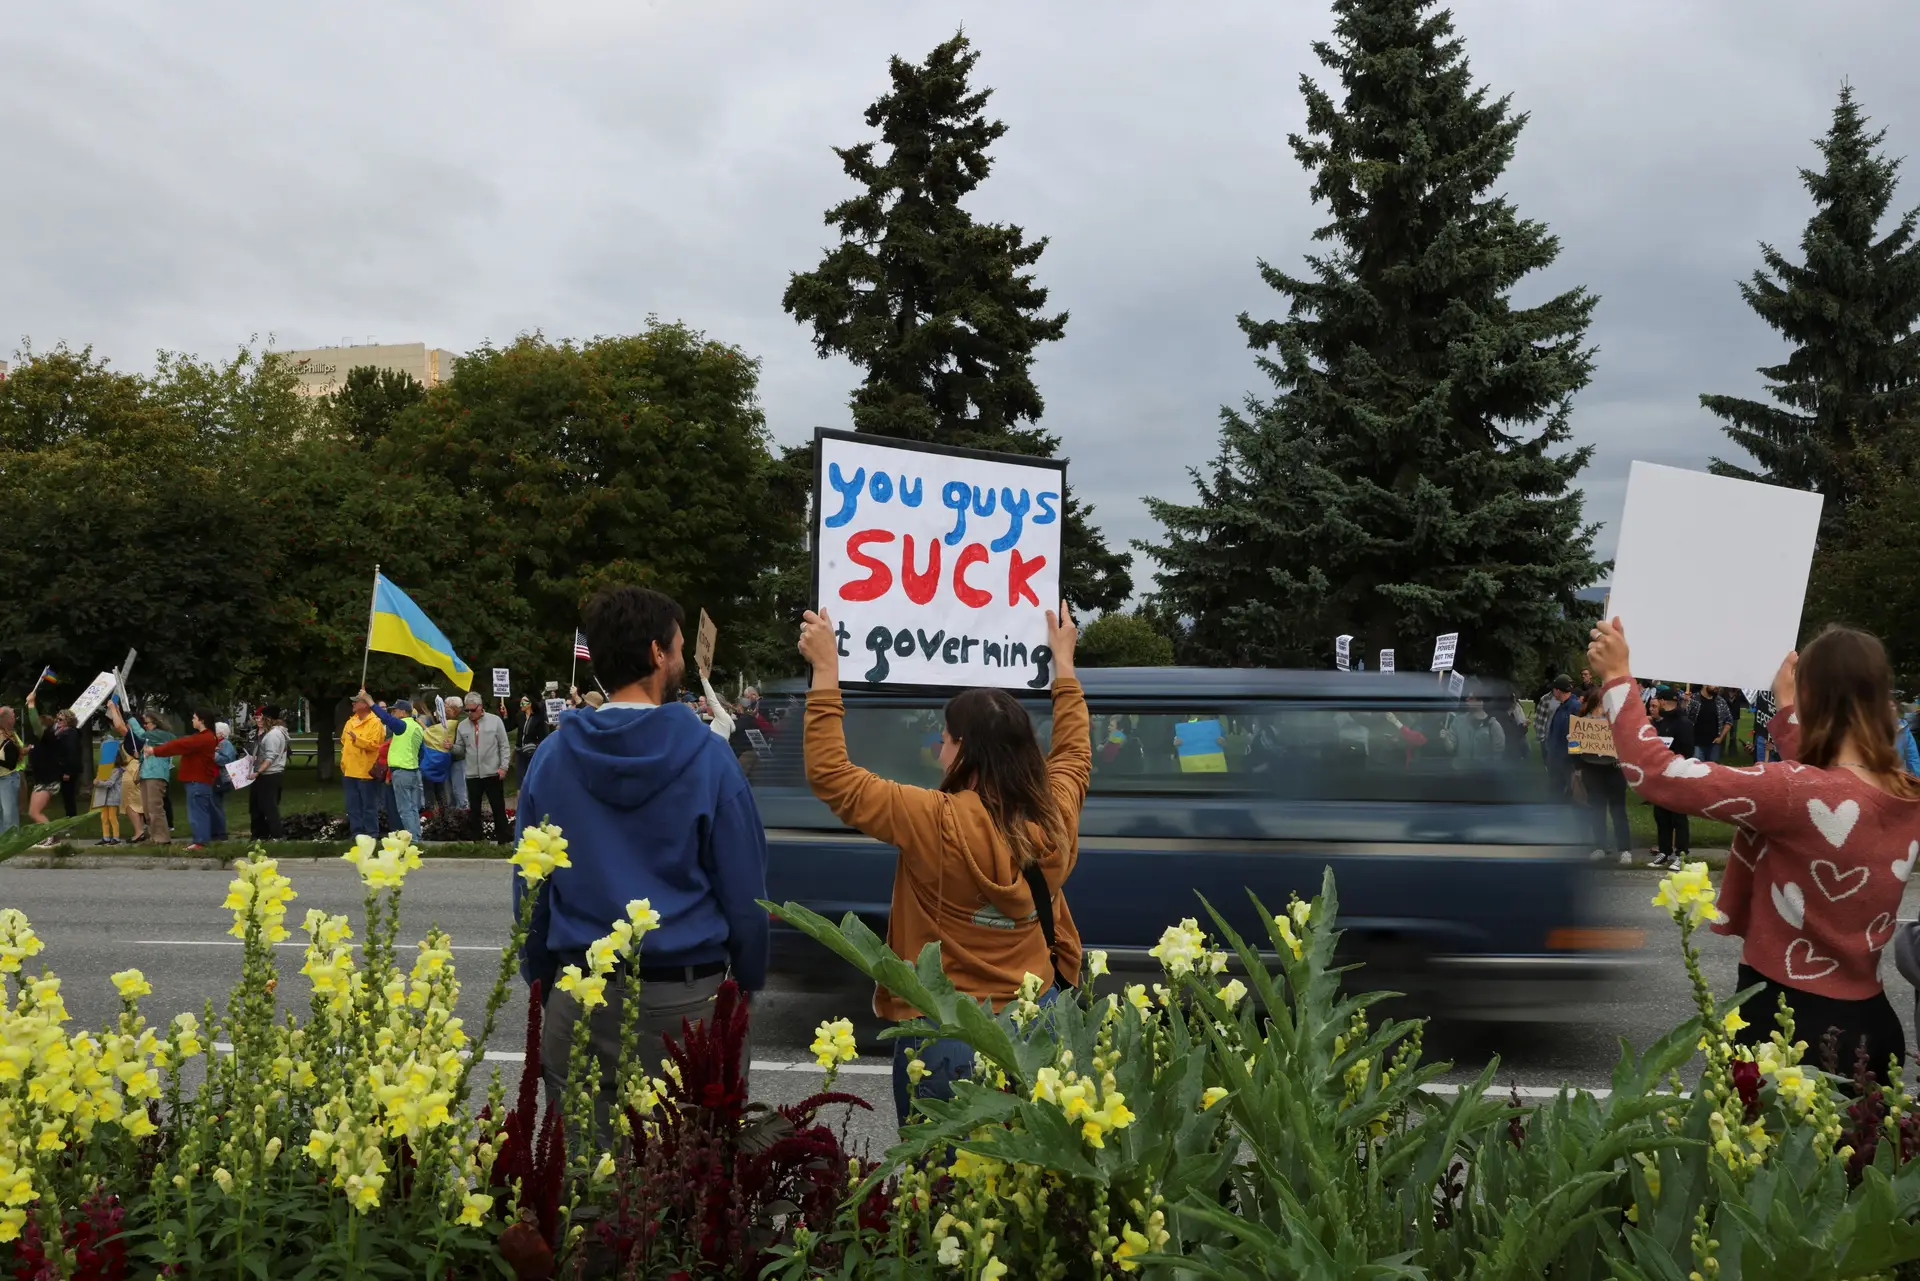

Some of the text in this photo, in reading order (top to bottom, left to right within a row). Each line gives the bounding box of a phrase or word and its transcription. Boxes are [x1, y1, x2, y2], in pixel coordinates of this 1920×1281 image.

[825, 462, 1059, 552] you guys
[838, 529, 1047, 608] SUCK
[835, 621, 1053, 689] t governing
[1579, 740, 1615, 752] UKRAIN
